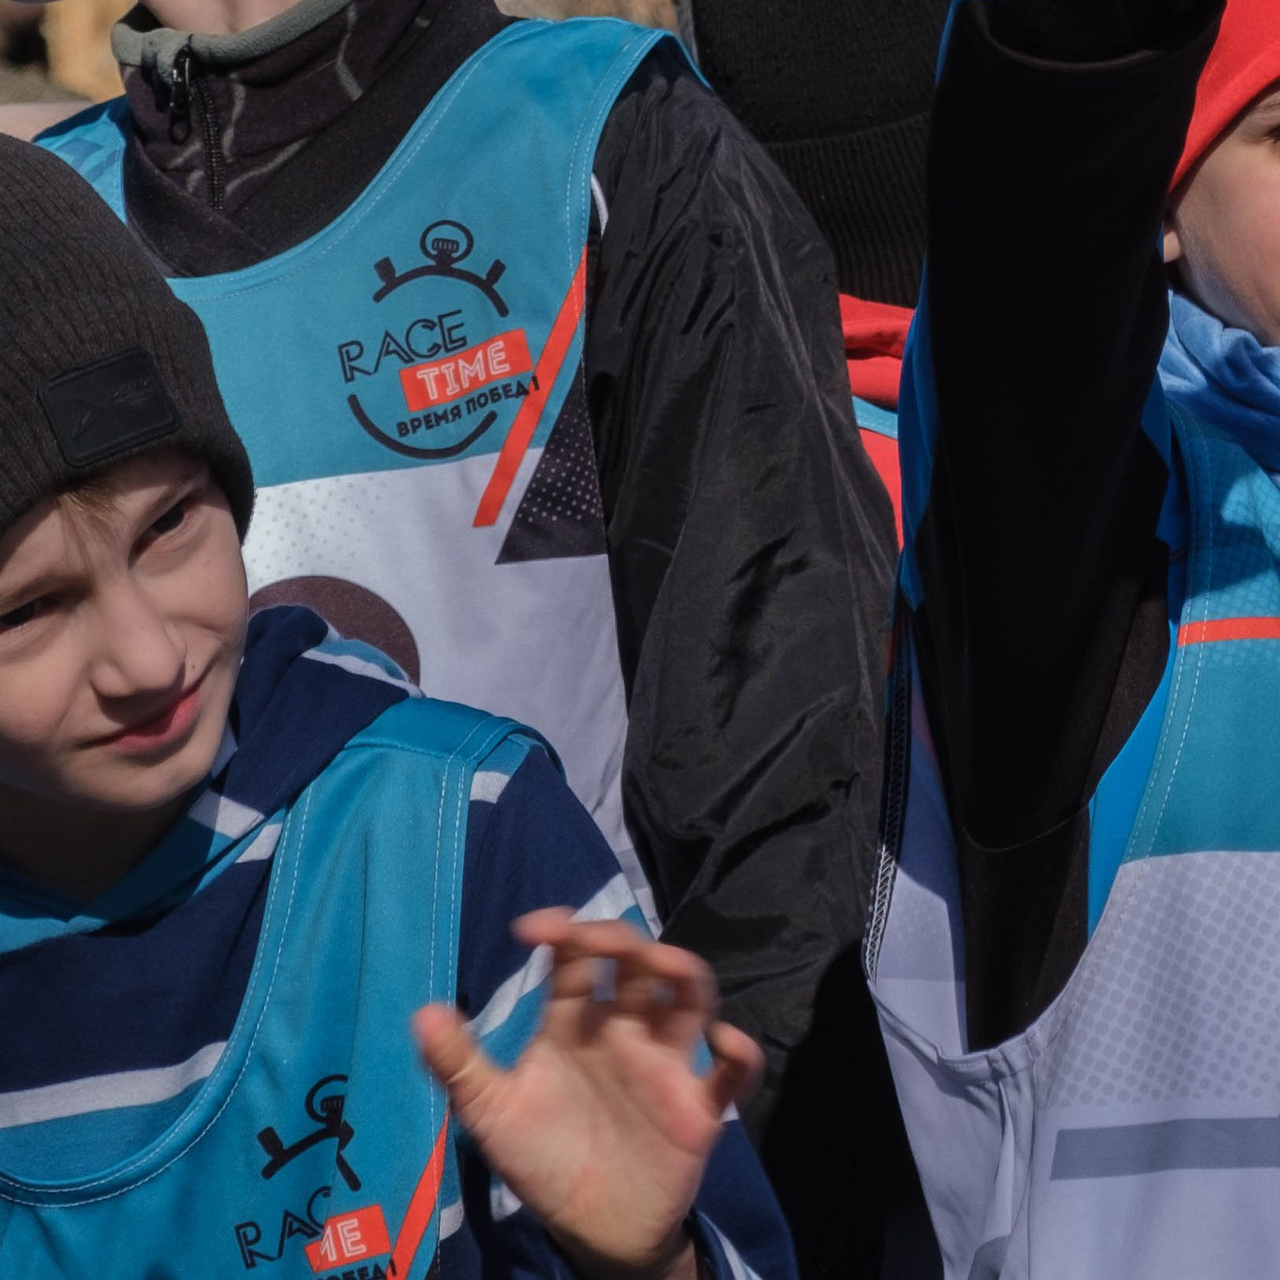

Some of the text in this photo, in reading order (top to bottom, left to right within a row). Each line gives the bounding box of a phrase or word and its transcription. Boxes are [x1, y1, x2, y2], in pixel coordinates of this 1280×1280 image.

[337, 309, 467, 383] RACE
[417, 340, 510, 400] TIME
[396, 404, 462, 438] ВРЕМЯ
[234, 1185, 332, 1270] RAC
